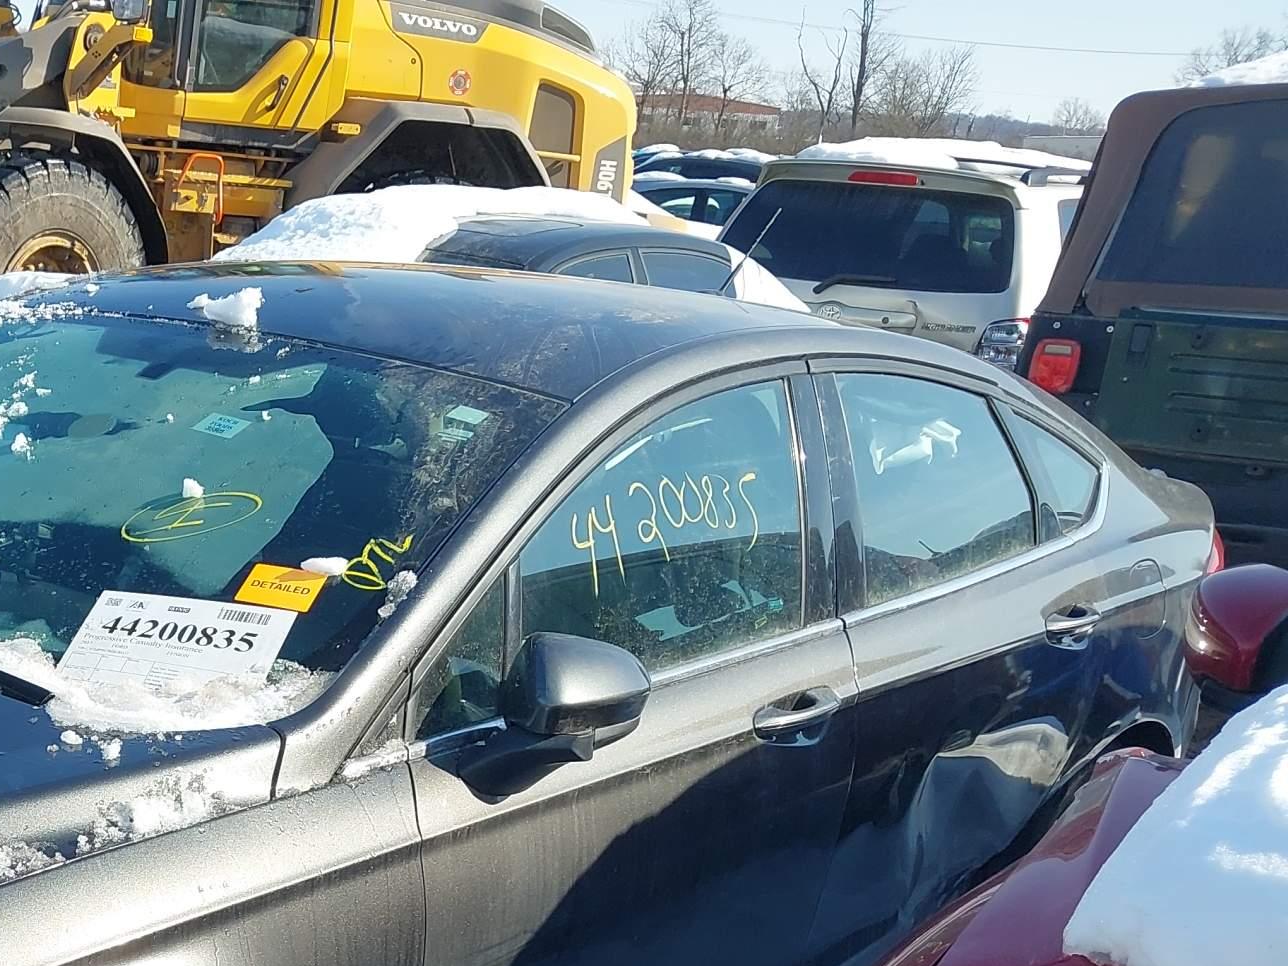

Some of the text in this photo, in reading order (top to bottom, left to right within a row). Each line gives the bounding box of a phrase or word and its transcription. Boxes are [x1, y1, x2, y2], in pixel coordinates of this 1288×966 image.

[398, 11, 477, 36] VOLVO
[250, 579, 311, 596] DETAILED
[83, 632, 129, 644] Progressive
[101, 615, 259, 653] 44200835
